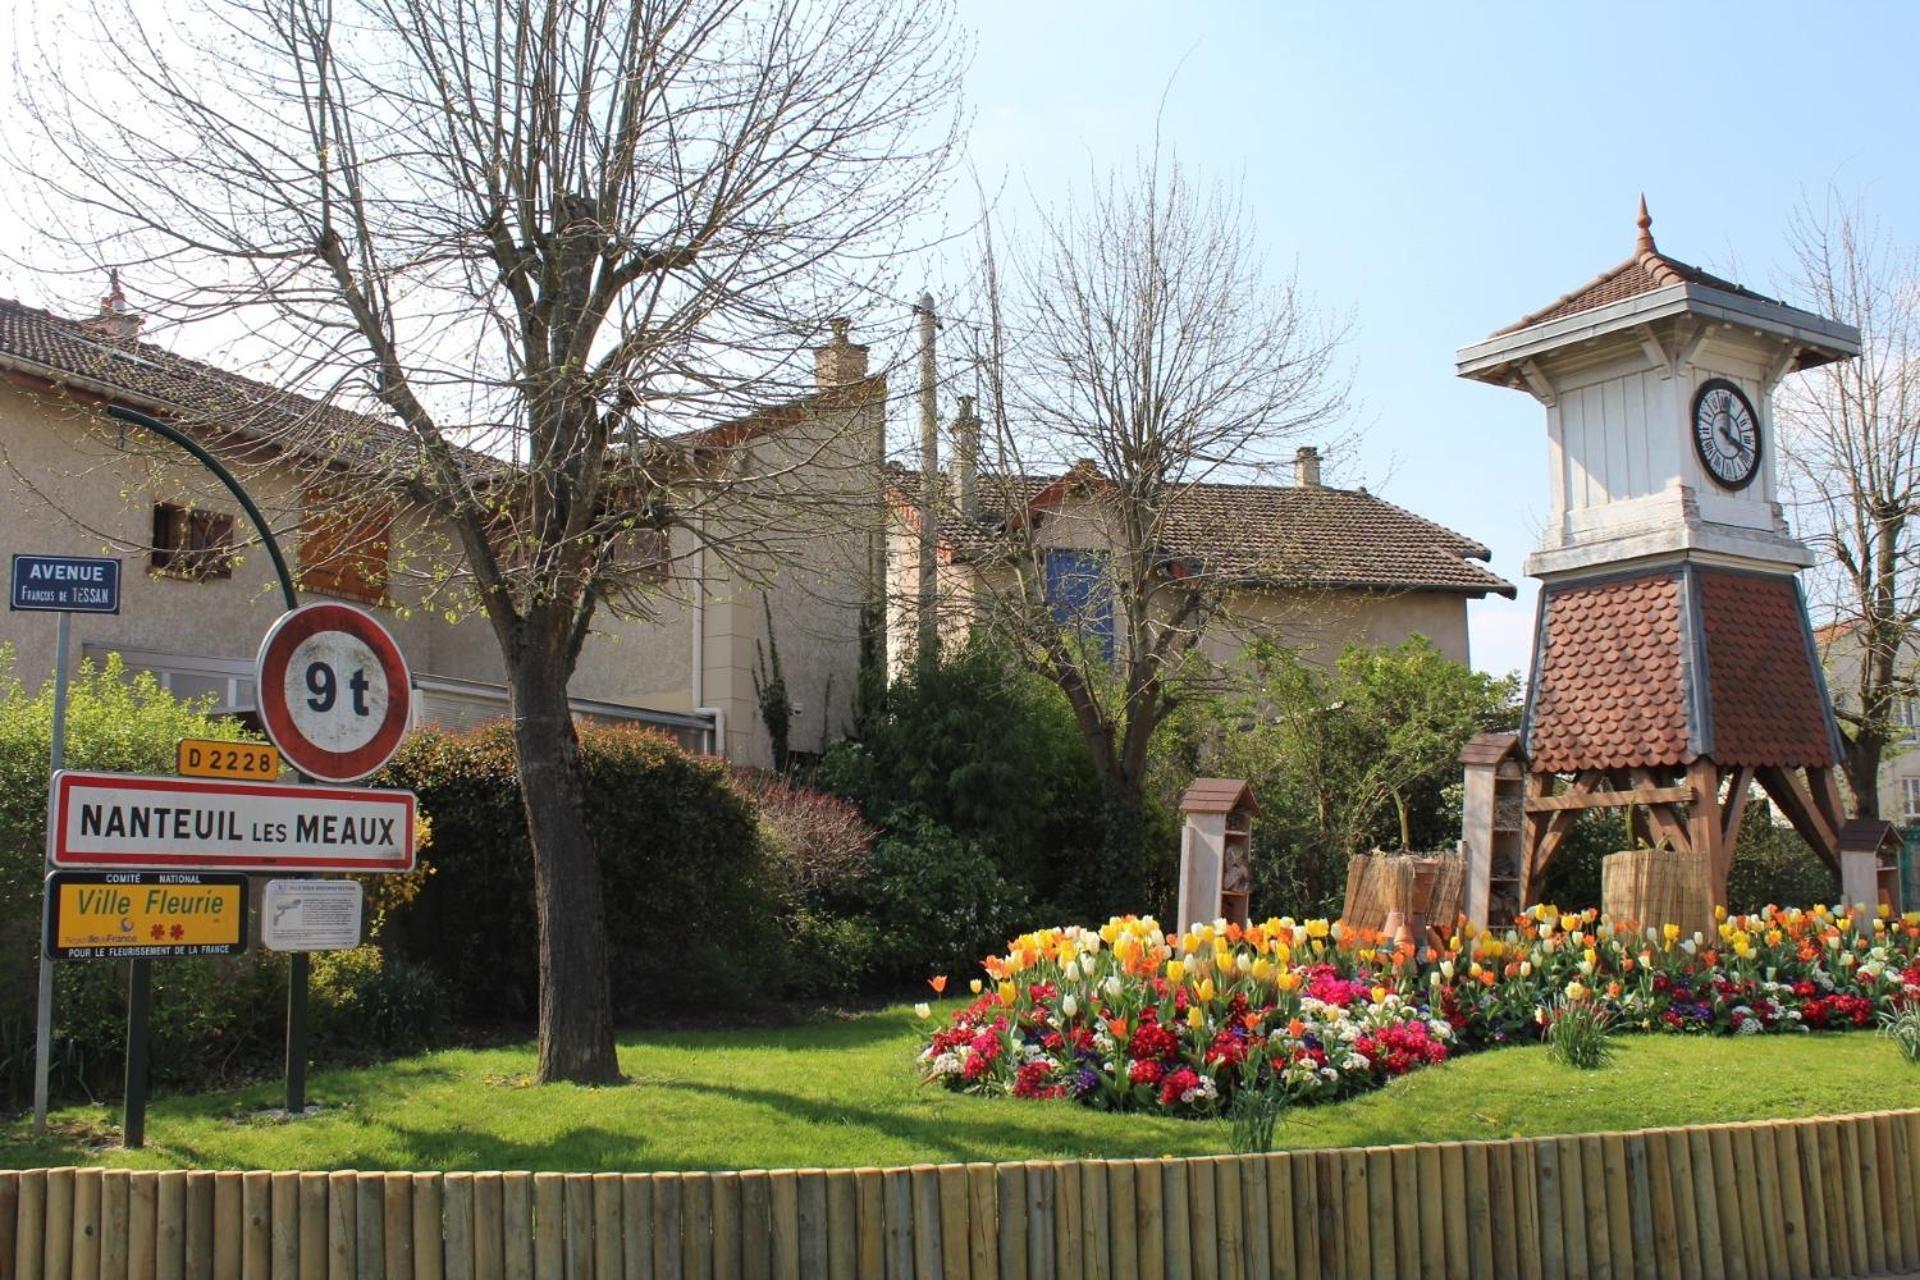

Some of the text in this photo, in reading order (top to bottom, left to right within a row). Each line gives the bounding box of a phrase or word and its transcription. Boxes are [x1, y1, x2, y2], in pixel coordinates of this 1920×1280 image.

[30, 563, 104, 581] AVENUE
[305, 661, 369, 716] 9 t
[188, 748, 271, 773] D 2228
[80, 803, 395, 846] NANTEUIL LES MEAUX
[106, 873, 201, 884] COMITÉ NATIONAL
[78, 889, 224, 915] Ville Fleurie
[68, 944, 230, 958] POUR LE FLEURISSEMENT DE LA FRANCE
